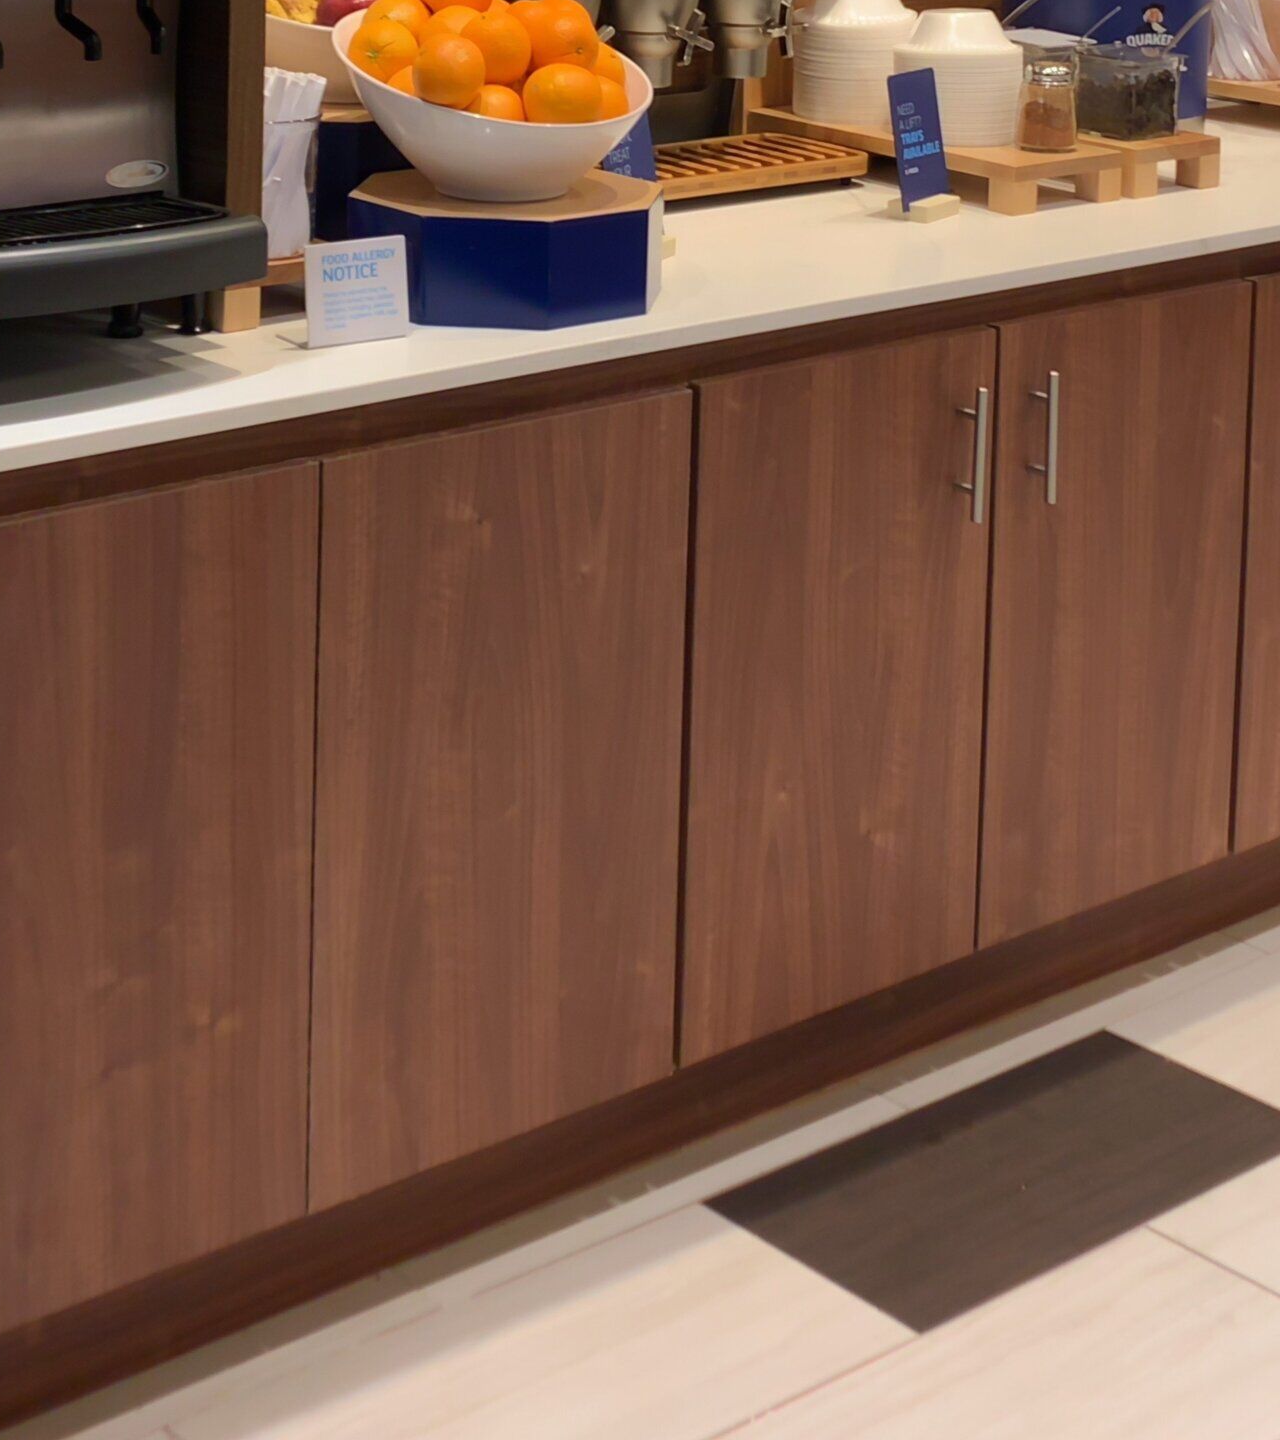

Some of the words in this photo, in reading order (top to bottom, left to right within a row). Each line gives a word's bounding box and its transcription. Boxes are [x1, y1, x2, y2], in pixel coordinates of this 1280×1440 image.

[322, 254, 349, 265] FOOD
[352, 248, 396, 261] ALLERGY
[323, 262, 379, 282] NOTICE
